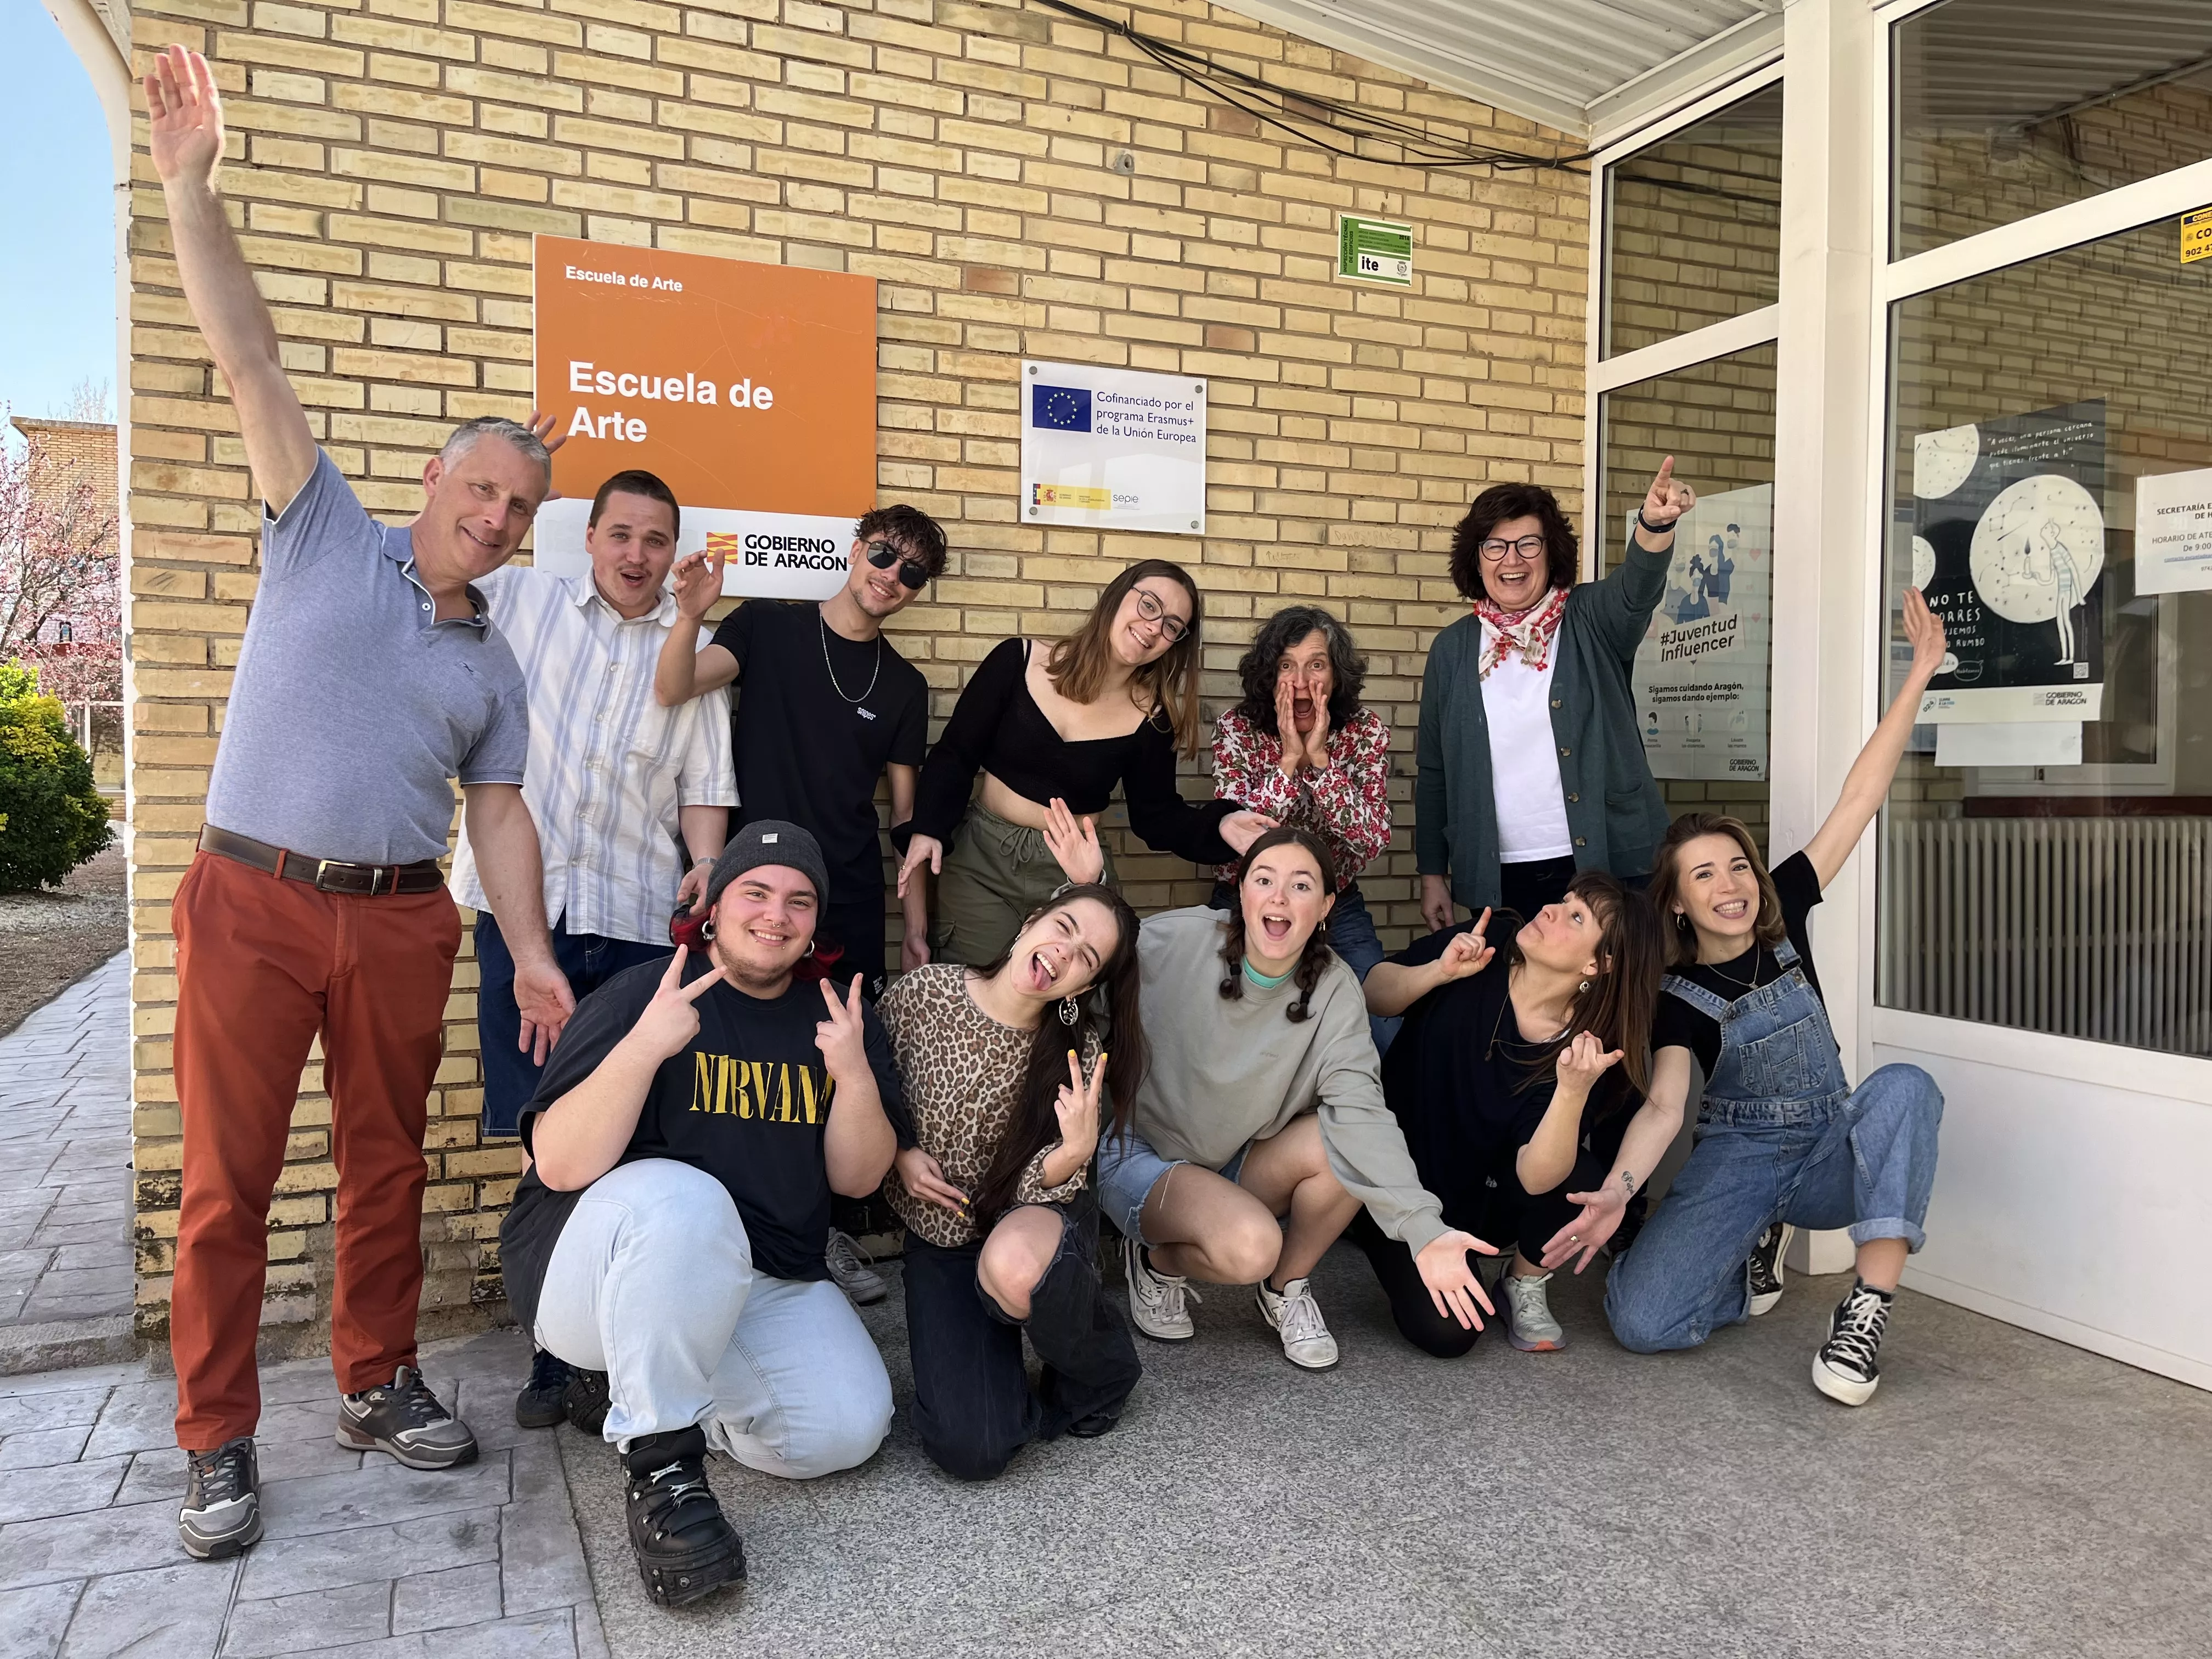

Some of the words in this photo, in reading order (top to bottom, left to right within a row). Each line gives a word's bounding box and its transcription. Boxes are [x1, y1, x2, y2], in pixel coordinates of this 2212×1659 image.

[2186, 247, 2202, 257] 902
[1362, 256, 1379, 271] ite
[565, 265, 625, 285] Escuela
[629, 274, 648, 288] de
[652, 277, 682, 292] Arte
[569, 361, 718, 404] Escuela
[729, 379, 774, 410] de
[1097, 392, 1161, 408] Cofinanciado
[1165, 401, 1182, 410] por
[1186, 401, 1193, 410] el
[567, 407, 647, 442] Arte
[1097, 410, 1143, 422] programa
[1148, 413, 1194, 426] Erasmus+
[1097, 425, 1108, 435] de
[1113, 425, 1120, 436] la
[1124, 427, 1153, 438] Unión
[1157, 430, 1196, 444] Europea
[2035, 428, 2061, 438] persona
[2064, 422, 2092, 431] cercana
[1113, 494, 1138, 504] sepie
[2157, 503, 2205, 515] SECRETARÍA
[745, 534, 835, 554] GOBIERNO
[2152, 534, 2185, 544] HORARIO
[745, 551, 768, 567] DE
[775, 554, 847, 571] ARAGON
[1929, 595, 1949, 607] NO
[1957, 590, 1973, 603] TE
[1939, 607, 1980, 622] ORRES
[1661, 614, 1737, 646] #Juventud
[1661, 635, 1734, 662] Influencer
[1956, 637, 1985, 647] RUMBO
[1649, 686, 1678, 694] Sigamos
[1679, 684, 1712, 692] cuidando
[1714, 682, 1743, 691] Aragón,
[1652, 694, 1680, 704] sigamos
[1706, 692, 1739, 703] ejemplo:
